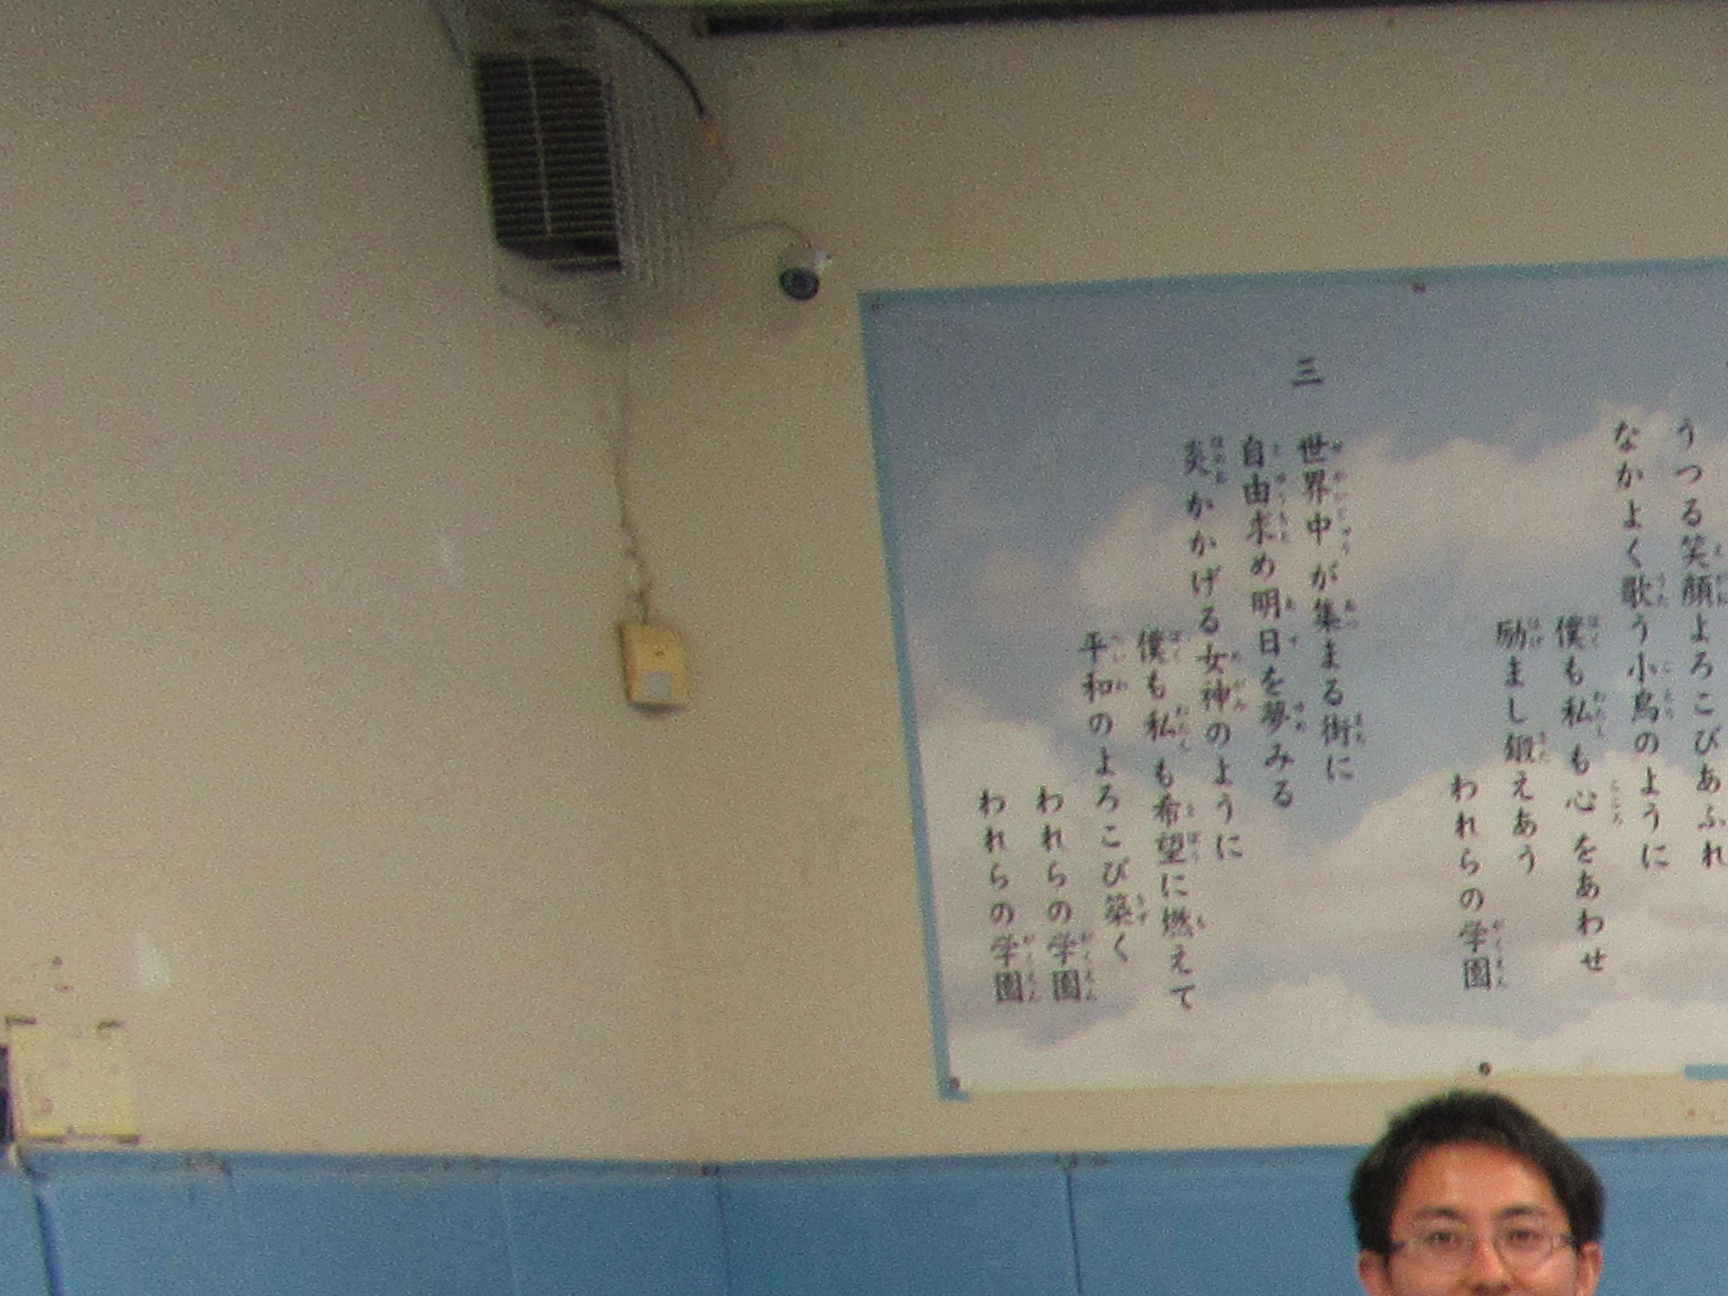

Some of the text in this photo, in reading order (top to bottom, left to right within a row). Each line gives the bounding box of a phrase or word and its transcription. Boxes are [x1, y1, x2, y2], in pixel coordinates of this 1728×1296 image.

[1292, 355, 1325, 387] 三
[979, 787, 1023, 1003] われらの学園
[1036, 784, 1081, 1003] われらの学園
[1450, 773, 1492, 991] われらの学園
